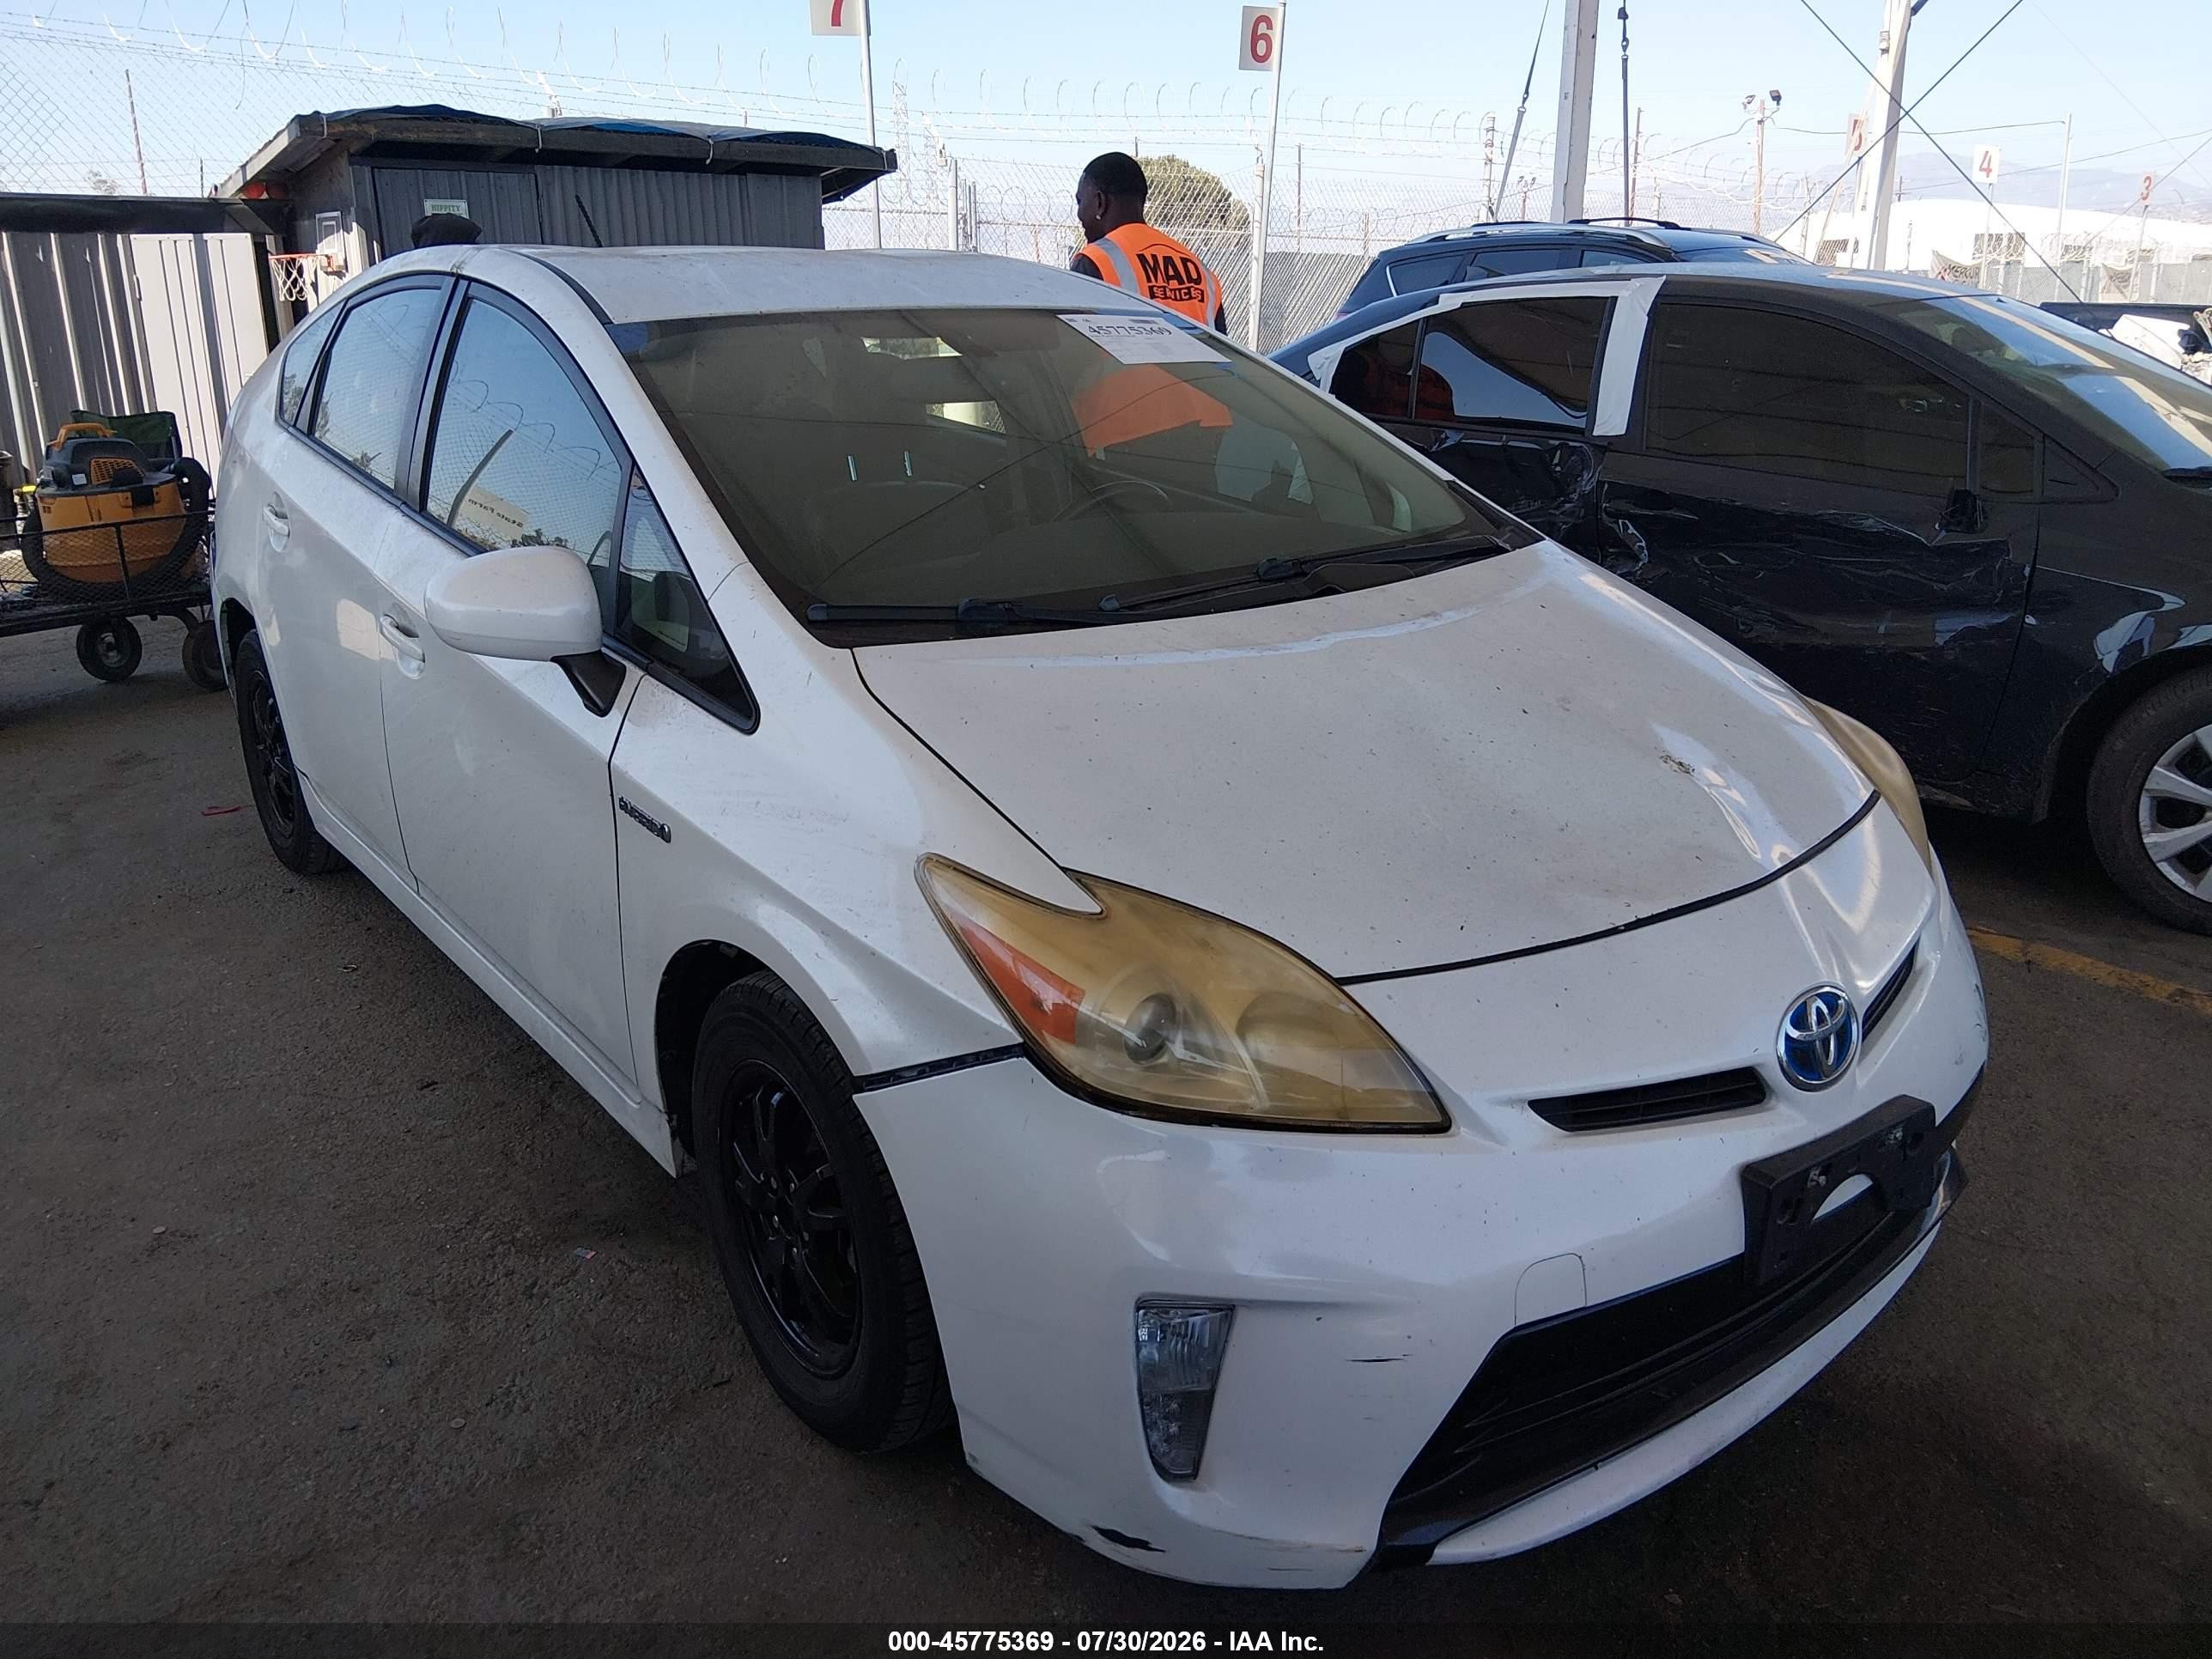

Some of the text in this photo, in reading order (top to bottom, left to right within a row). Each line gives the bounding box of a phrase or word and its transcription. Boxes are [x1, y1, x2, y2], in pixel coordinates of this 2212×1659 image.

[1251, 15, 1273, 63] 6
[1978, 151, 1992, 178] 4
[2141, 176, 2152, 201] 3
[1135, 253, 1202, 285] MAD
[1088, 325, 1173, 336] 45775369
